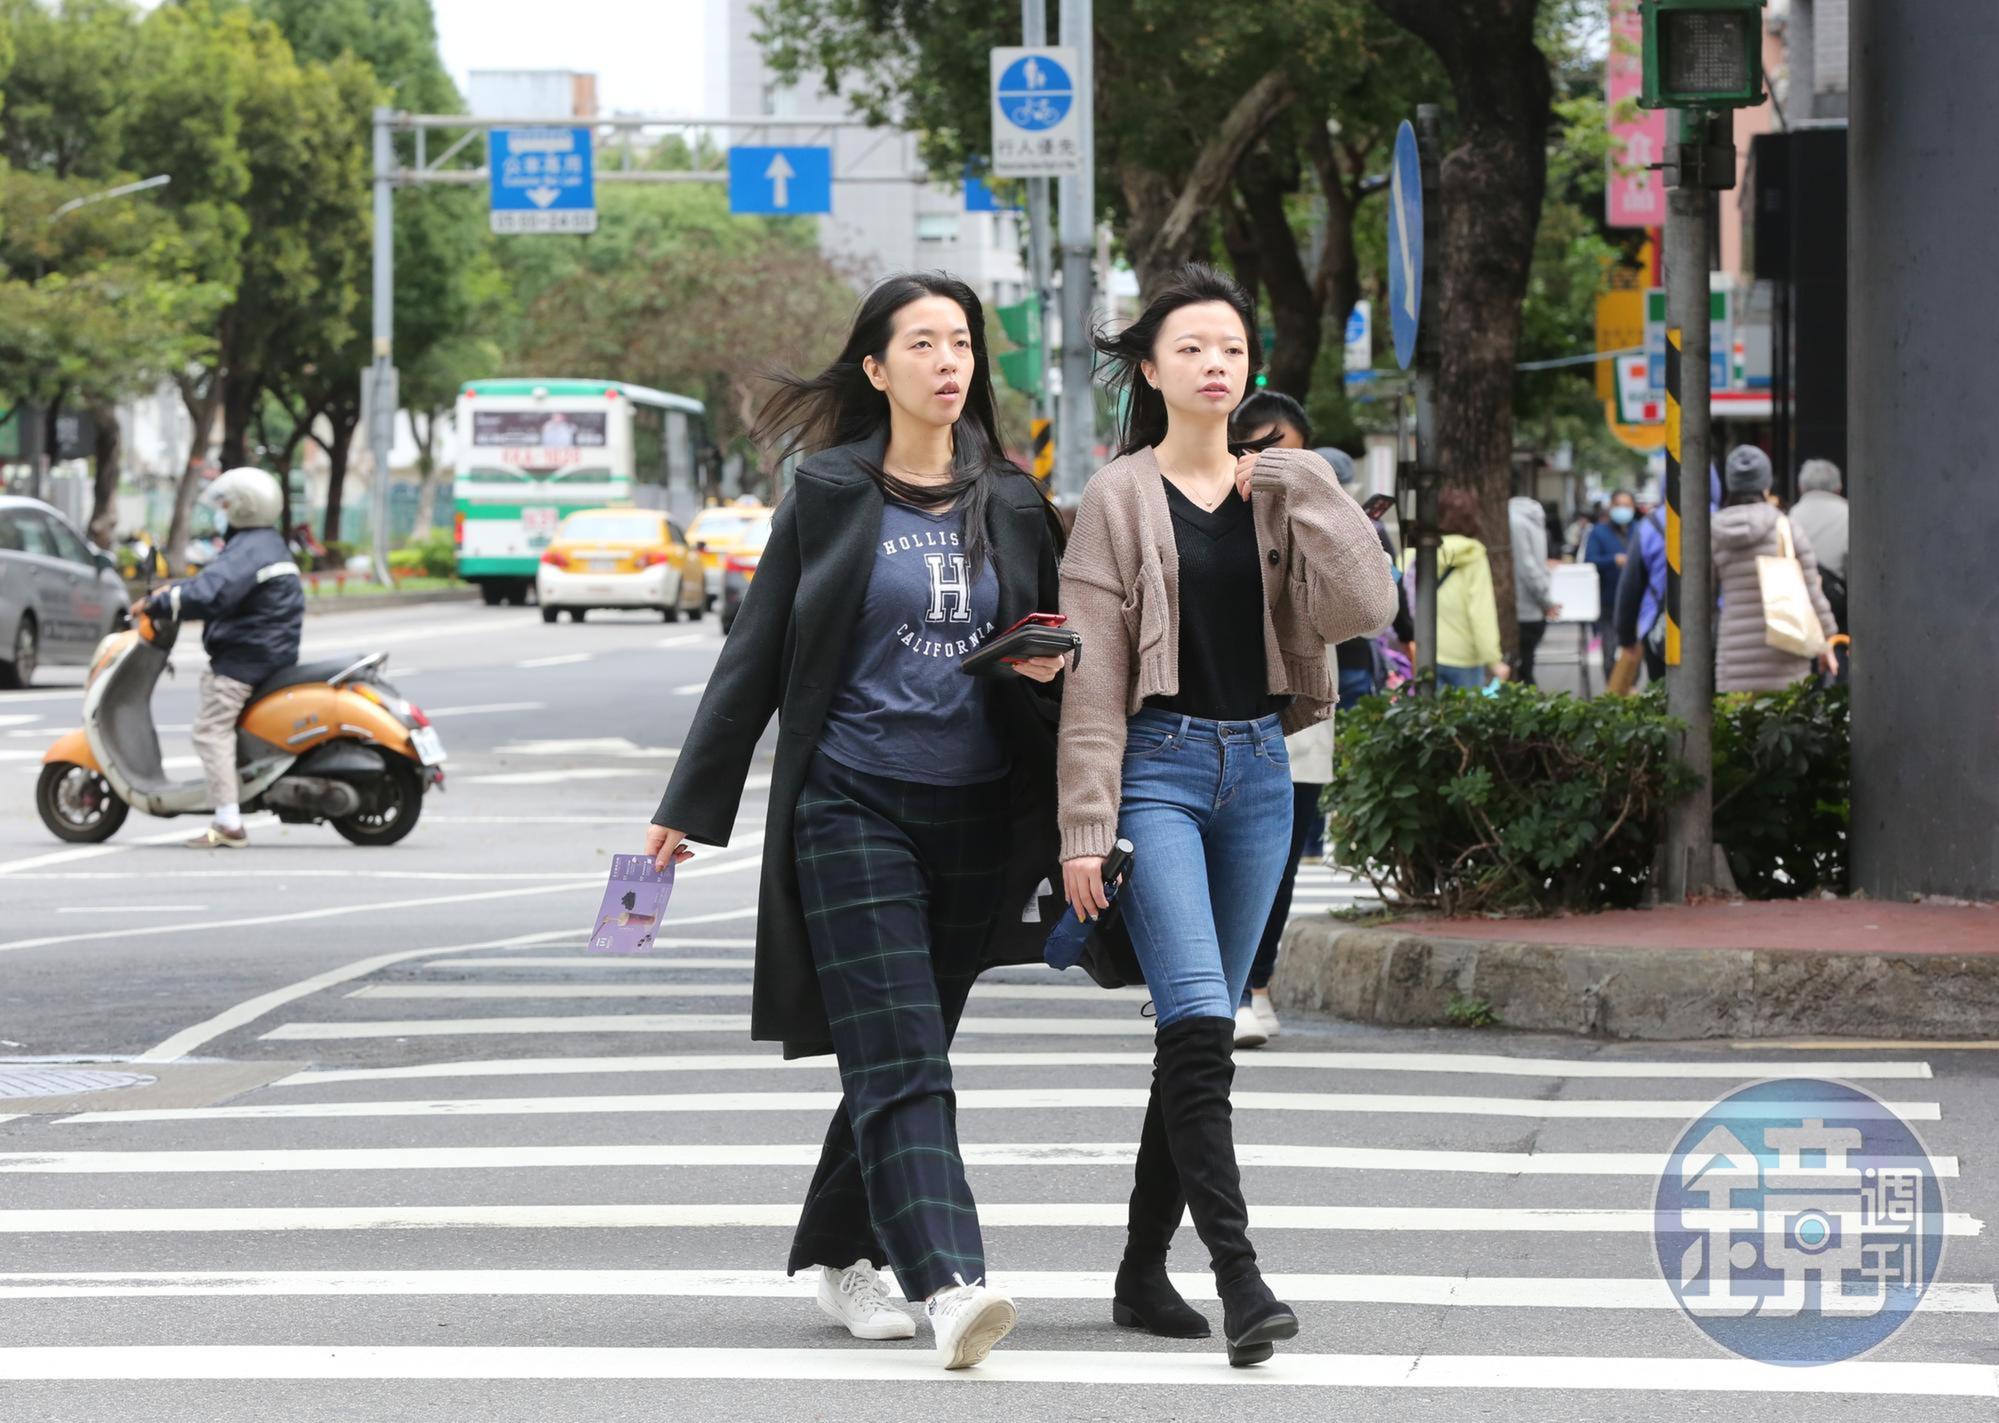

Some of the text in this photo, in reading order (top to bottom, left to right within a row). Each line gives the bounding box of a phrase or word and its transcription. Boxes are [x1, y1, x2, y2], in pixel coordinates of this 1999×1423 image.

[998, 138, 1076, 156] 行人優先
[883, 531, 960, 555] HOLLIS
[924, 553, 972, 623] H
[896, 620, 996, 658] CALIFORNIA
